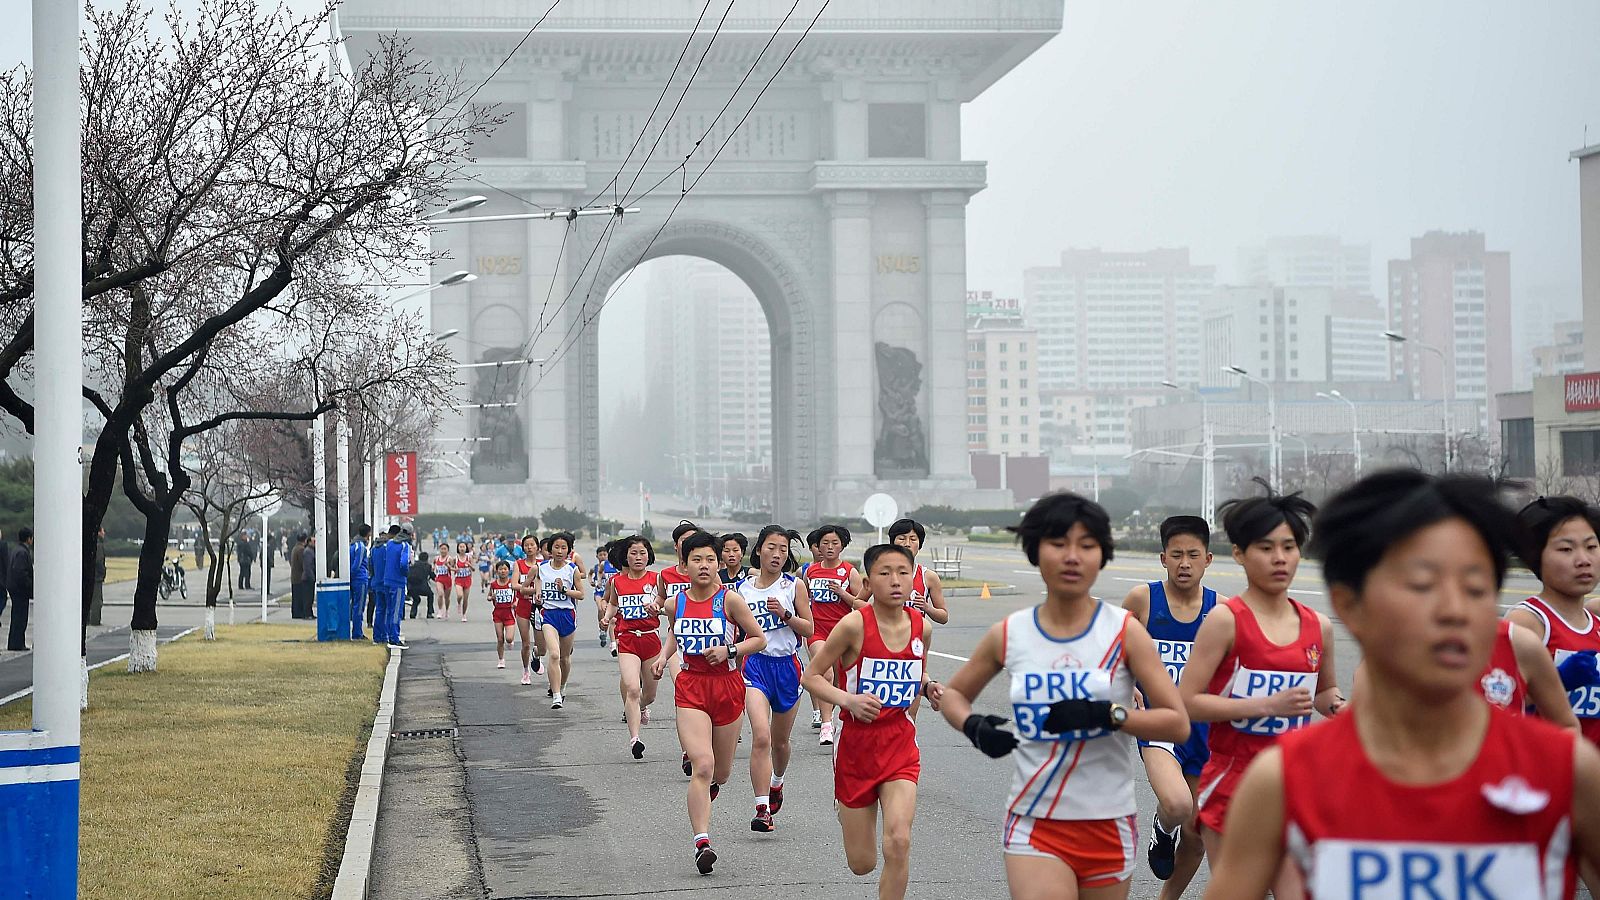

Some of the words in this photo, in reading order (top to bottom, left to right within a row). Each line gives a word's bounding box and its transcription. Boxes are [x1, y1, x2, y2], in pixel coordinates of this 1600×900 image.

[476, 256, 521, 274] 1925
[877, 256, 920, 273] 1945
[622, 596, 644, 606] PRK
[748, 601, 768, 613] PR
[681, 620, 714, 633] PRK
[1158, 641, 1194, 661] PR
[872, 660, 914, 680] PRK
[862, 682, 915, 706] 3054
[1025, 672, 1093, 700] PRK
[1247, 673, 1306, 697] PRK
[1351, 850, 1499, 900] PRK
